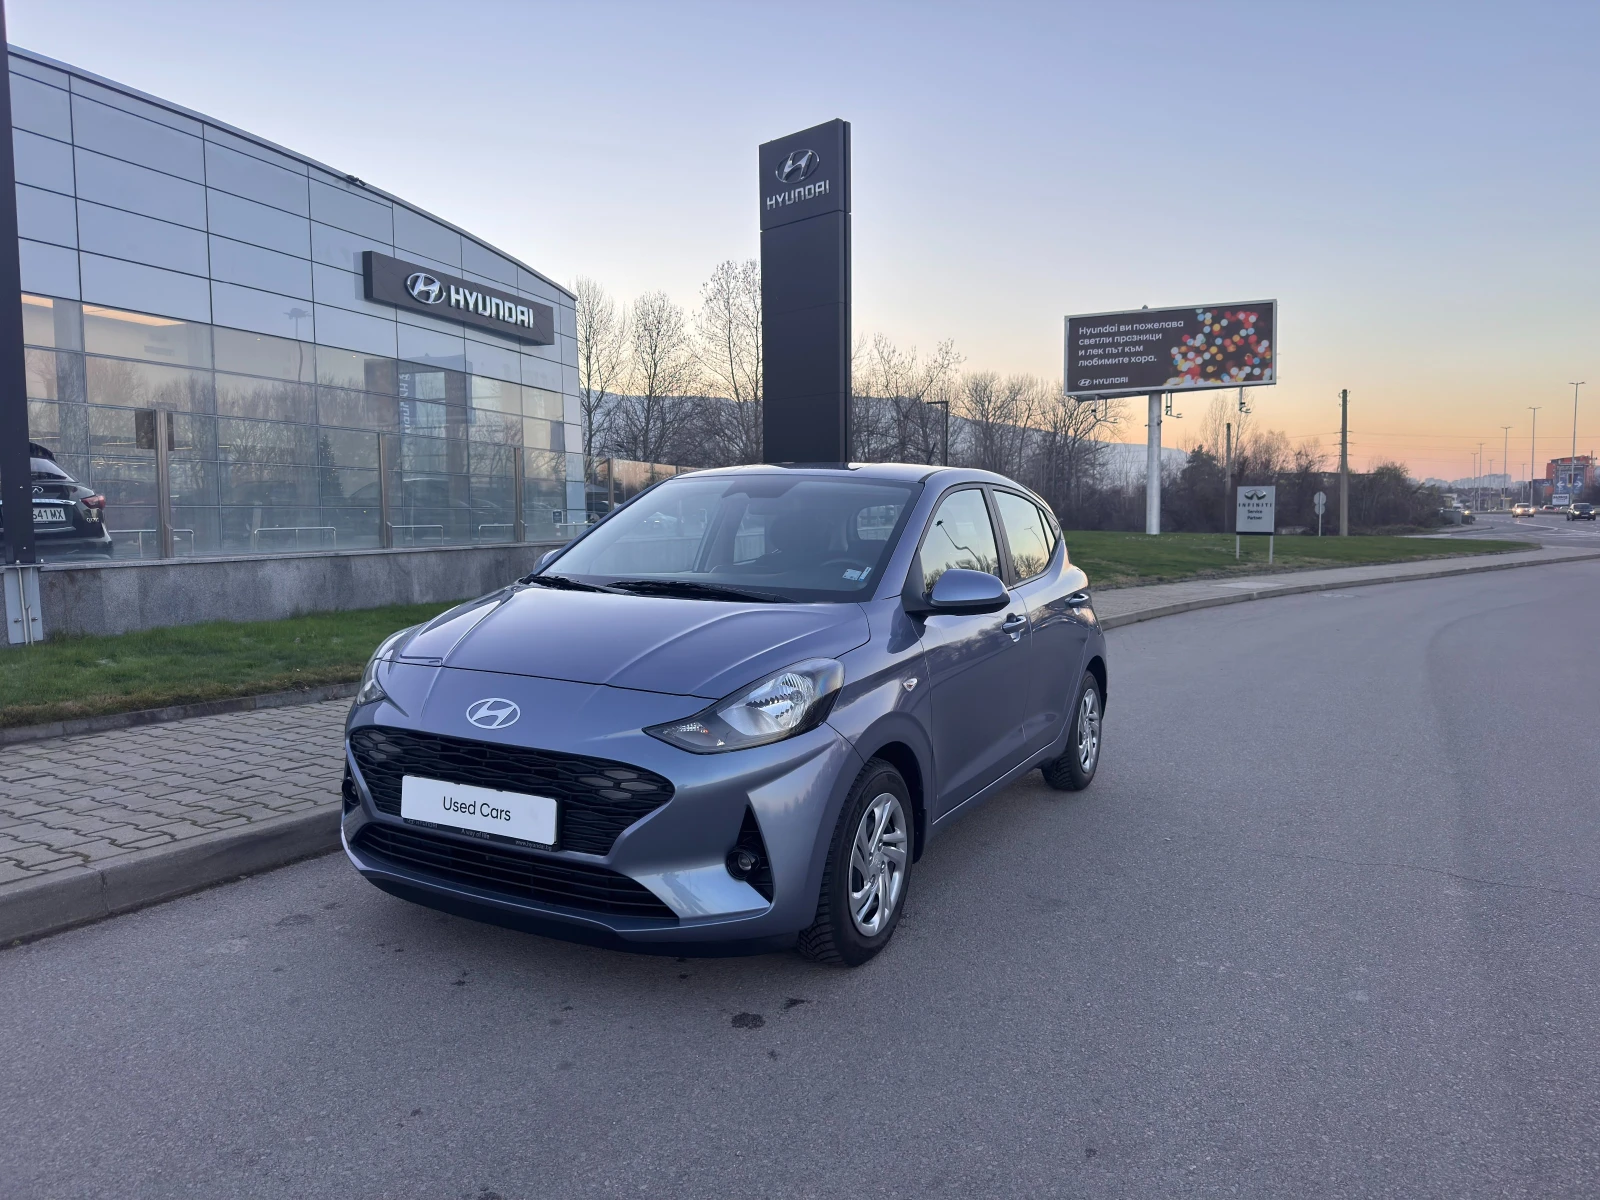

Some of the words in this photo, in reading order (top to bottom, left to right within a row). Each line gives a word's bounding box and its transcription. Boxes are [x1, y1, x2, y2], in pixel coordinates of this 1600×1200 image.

[767, 179, 830, 211] HYUNDAI
[450, 284, 534, 329] HYUNDAI
[1078, 323, 1118, 336] Hyundai
[1133, 320, 1184, 331] пожелава
[1078, 336, 1112, 346] светли
[1114, 333, 1162, 344] празници
[1124, 345, 1144, 353] към
[1078, 357, 1129, 367] любимите
[1130, 355, 1157, 363] хора.
[1093, 376, 1129, 385] HYUNDAI
[442, 795, 477, 816] Used
[479, 802, 512, 822] Cars
